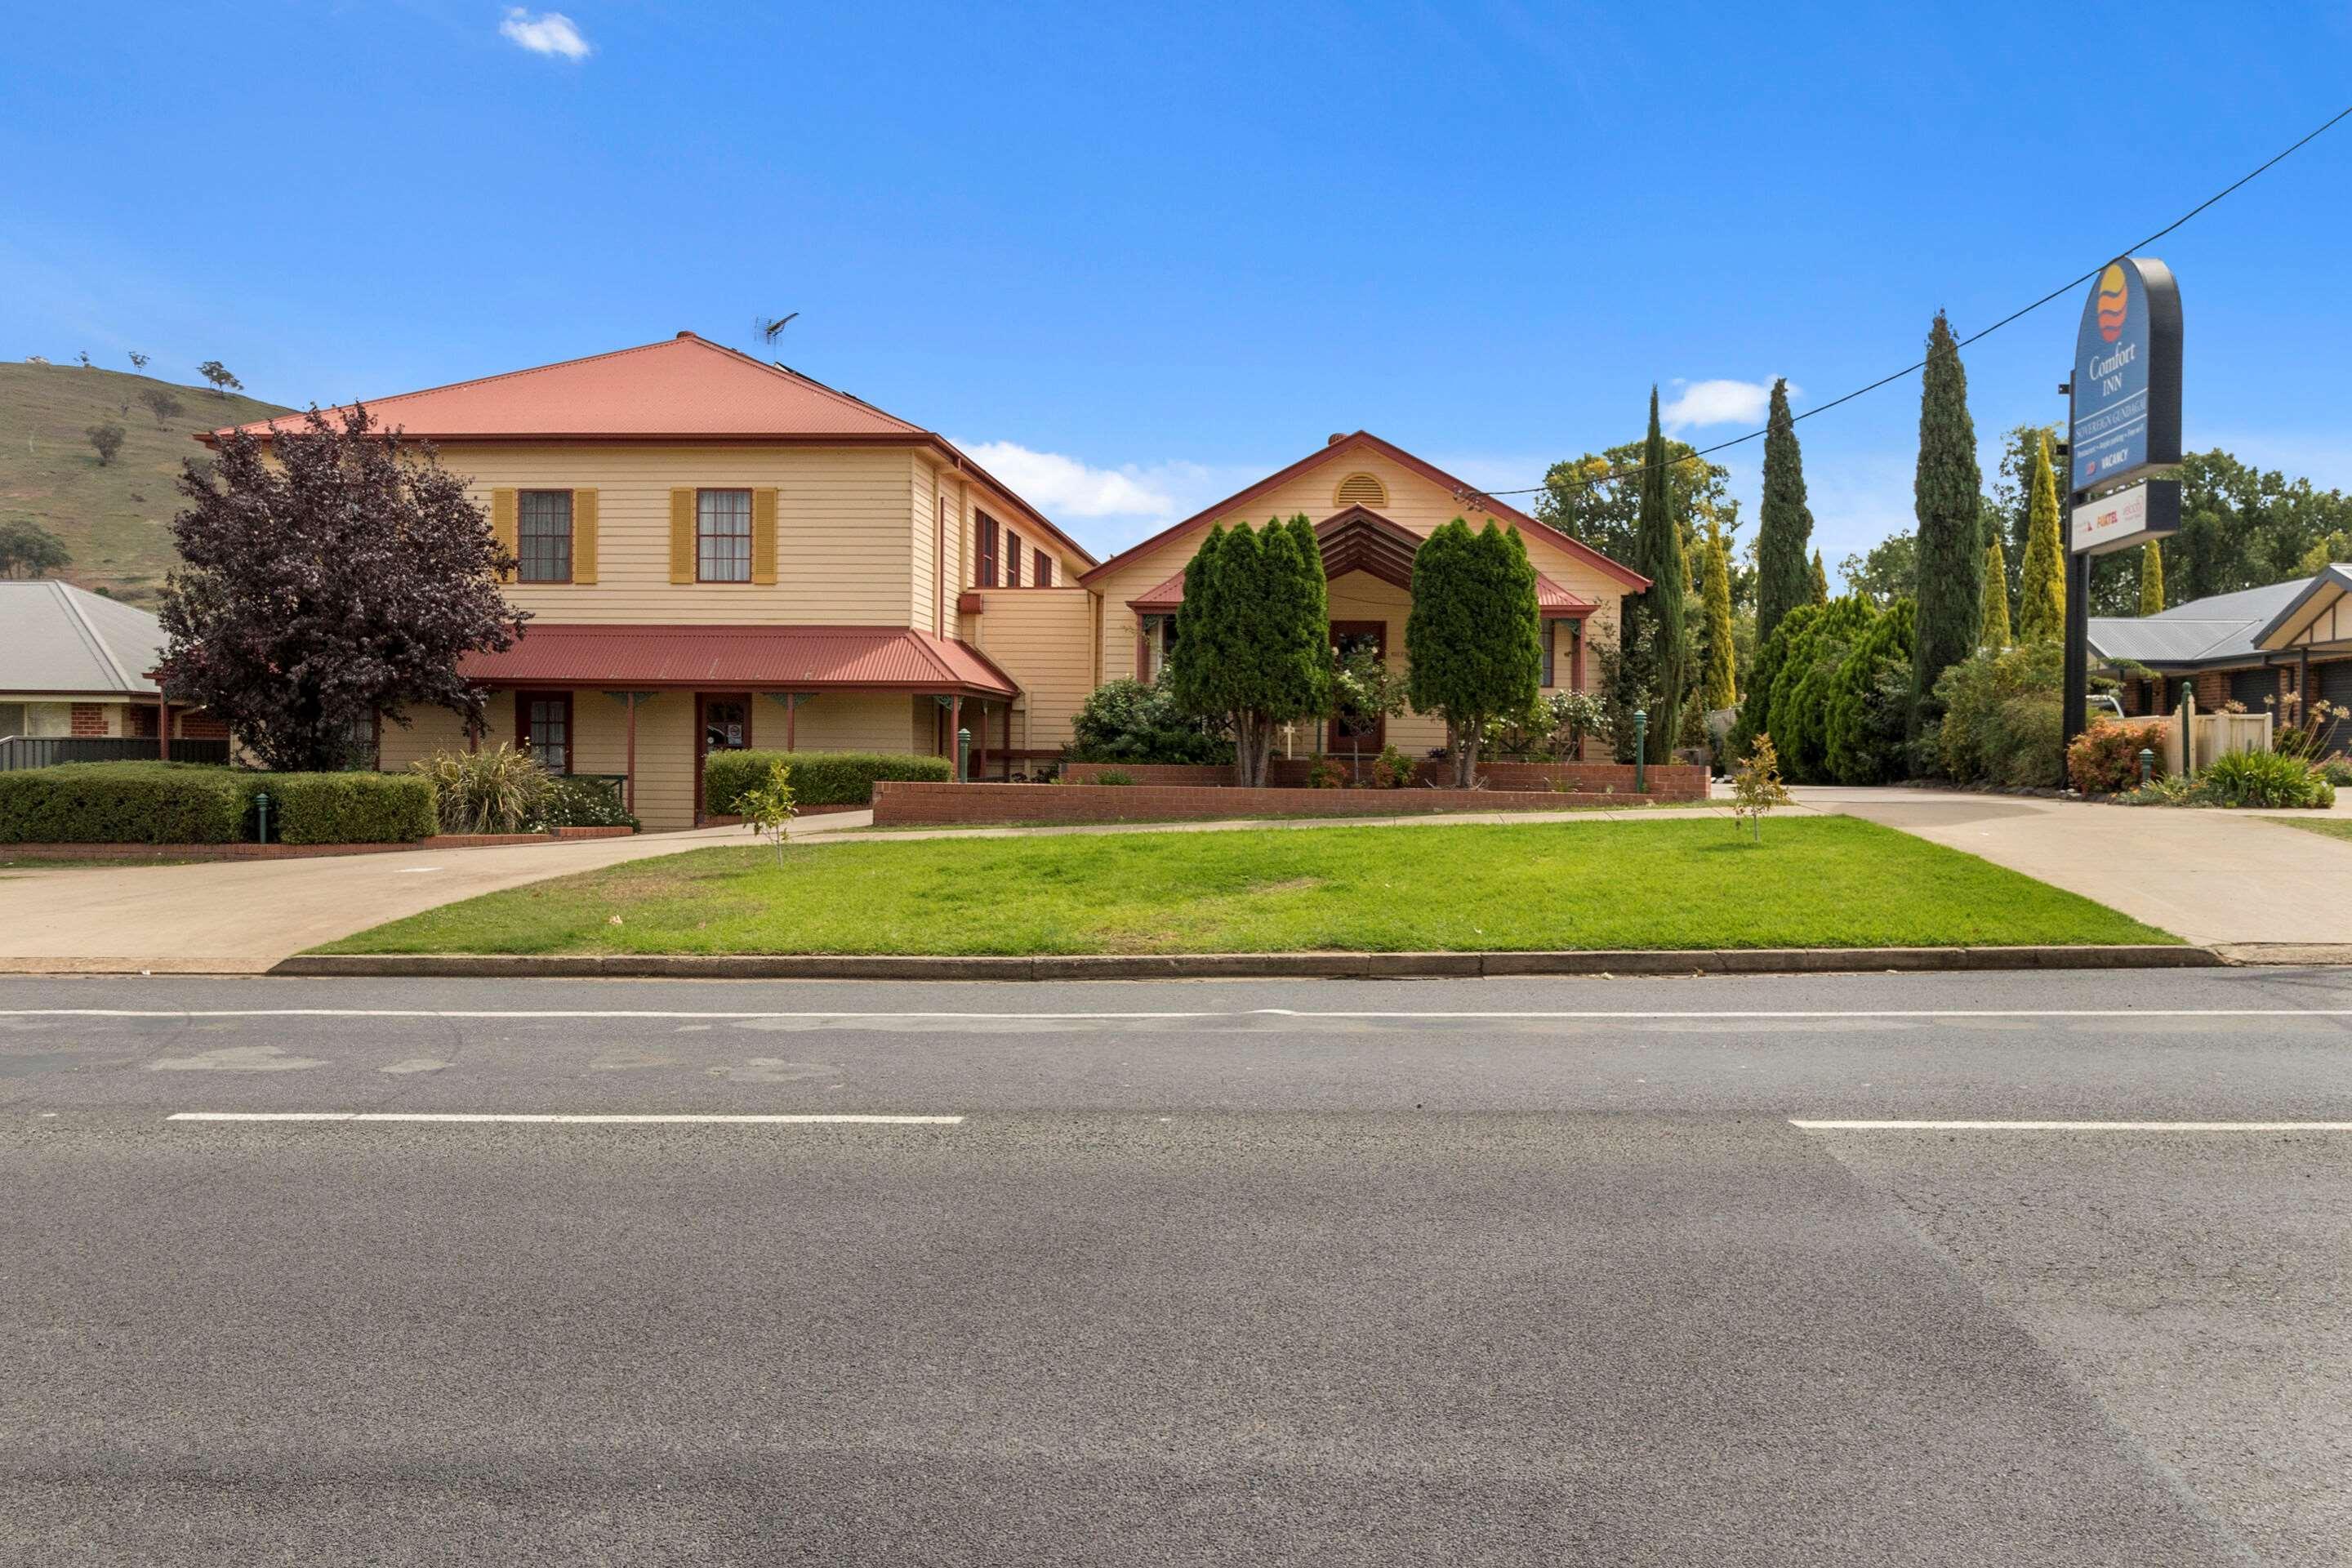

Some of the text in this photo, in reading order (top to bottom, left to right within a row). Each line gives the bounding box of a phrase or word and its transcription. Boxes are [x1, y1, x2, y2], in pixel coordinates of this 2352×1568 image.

[2089, 341, 2136, 381] Comfort
[2103, 372, 2123, 397] INN
[2101, 448, 2128, 470] VACANCY
